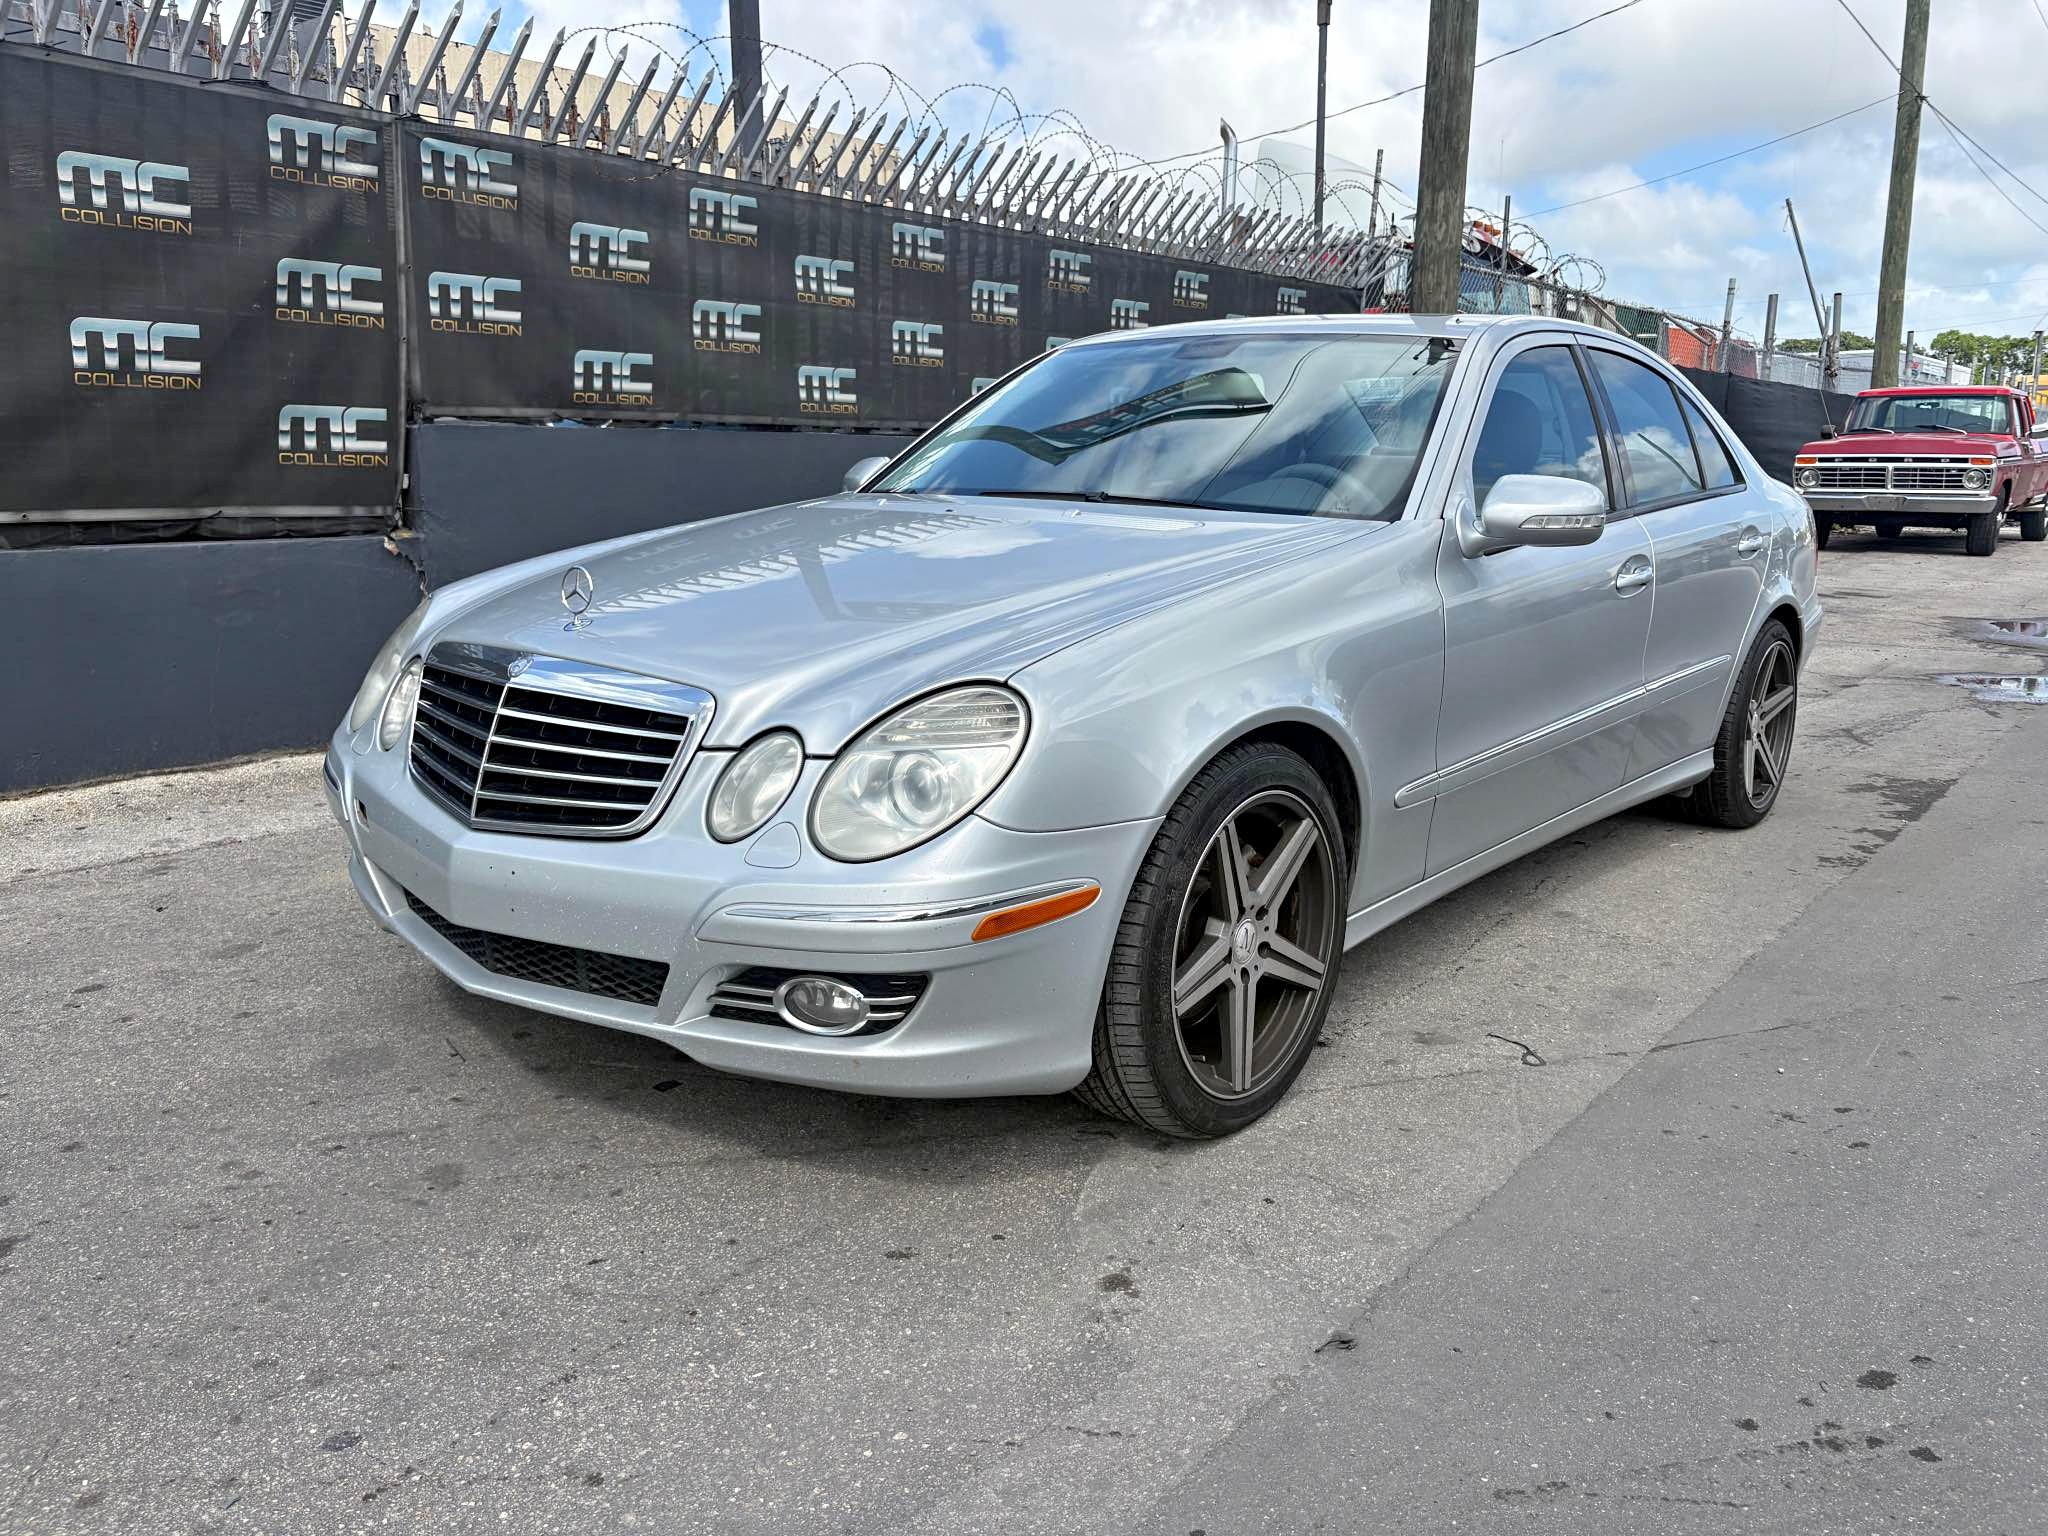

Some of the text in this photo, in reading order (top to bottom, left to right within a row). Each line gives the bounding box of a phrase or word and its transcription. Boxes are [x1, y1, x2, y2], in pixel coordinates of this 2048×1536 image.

[267, 114, 379, 177] MC
[57, 151, 192, 218] MC
[270, 165, 379, 193] COLLISION
[420, 137, 518, 197] MC
[422, 185, 518, 210] COLLISION
[689, 187, 758, 234] MC
[61, 207, 192, 235] COLLISION
[689, 228, 758, 248] COLLISION
[570, 221, 650, 272] MC
[892, 222, 945, 263] MC
[571, 265, 650, 285] COLLISION
[795, 255, 855, 297] MC
[891, 258, 945, 273] COLLISION
[276, 257, 384, 314] MC
[428, 271, 522, 323] MC
[797, 292, 855, 308] COLLISION
[971, 280, 1019, 317] MC
[275, 308, 384, 330] COLLISION
[431, 318, 522, 337] COLLISION
[692, 300, 761, 343] MC
[70, 316, 201, 374] MC
[694, 339, 761, 355] COLLISION
[892, 320, 944, 358] MC
[574, 349, 653, 394] MC
[892, 355, 944, 368] COLLISION
[74, 371, 201, 391] COLLISION
[573, 392, 653, 406] COLLISION
[798, 365, 857, 403] MC
[800, 402, 858, 416] COLLISION
[279, 404, 388, 453] MC
[278, 452, 389, 467] COLLISION
